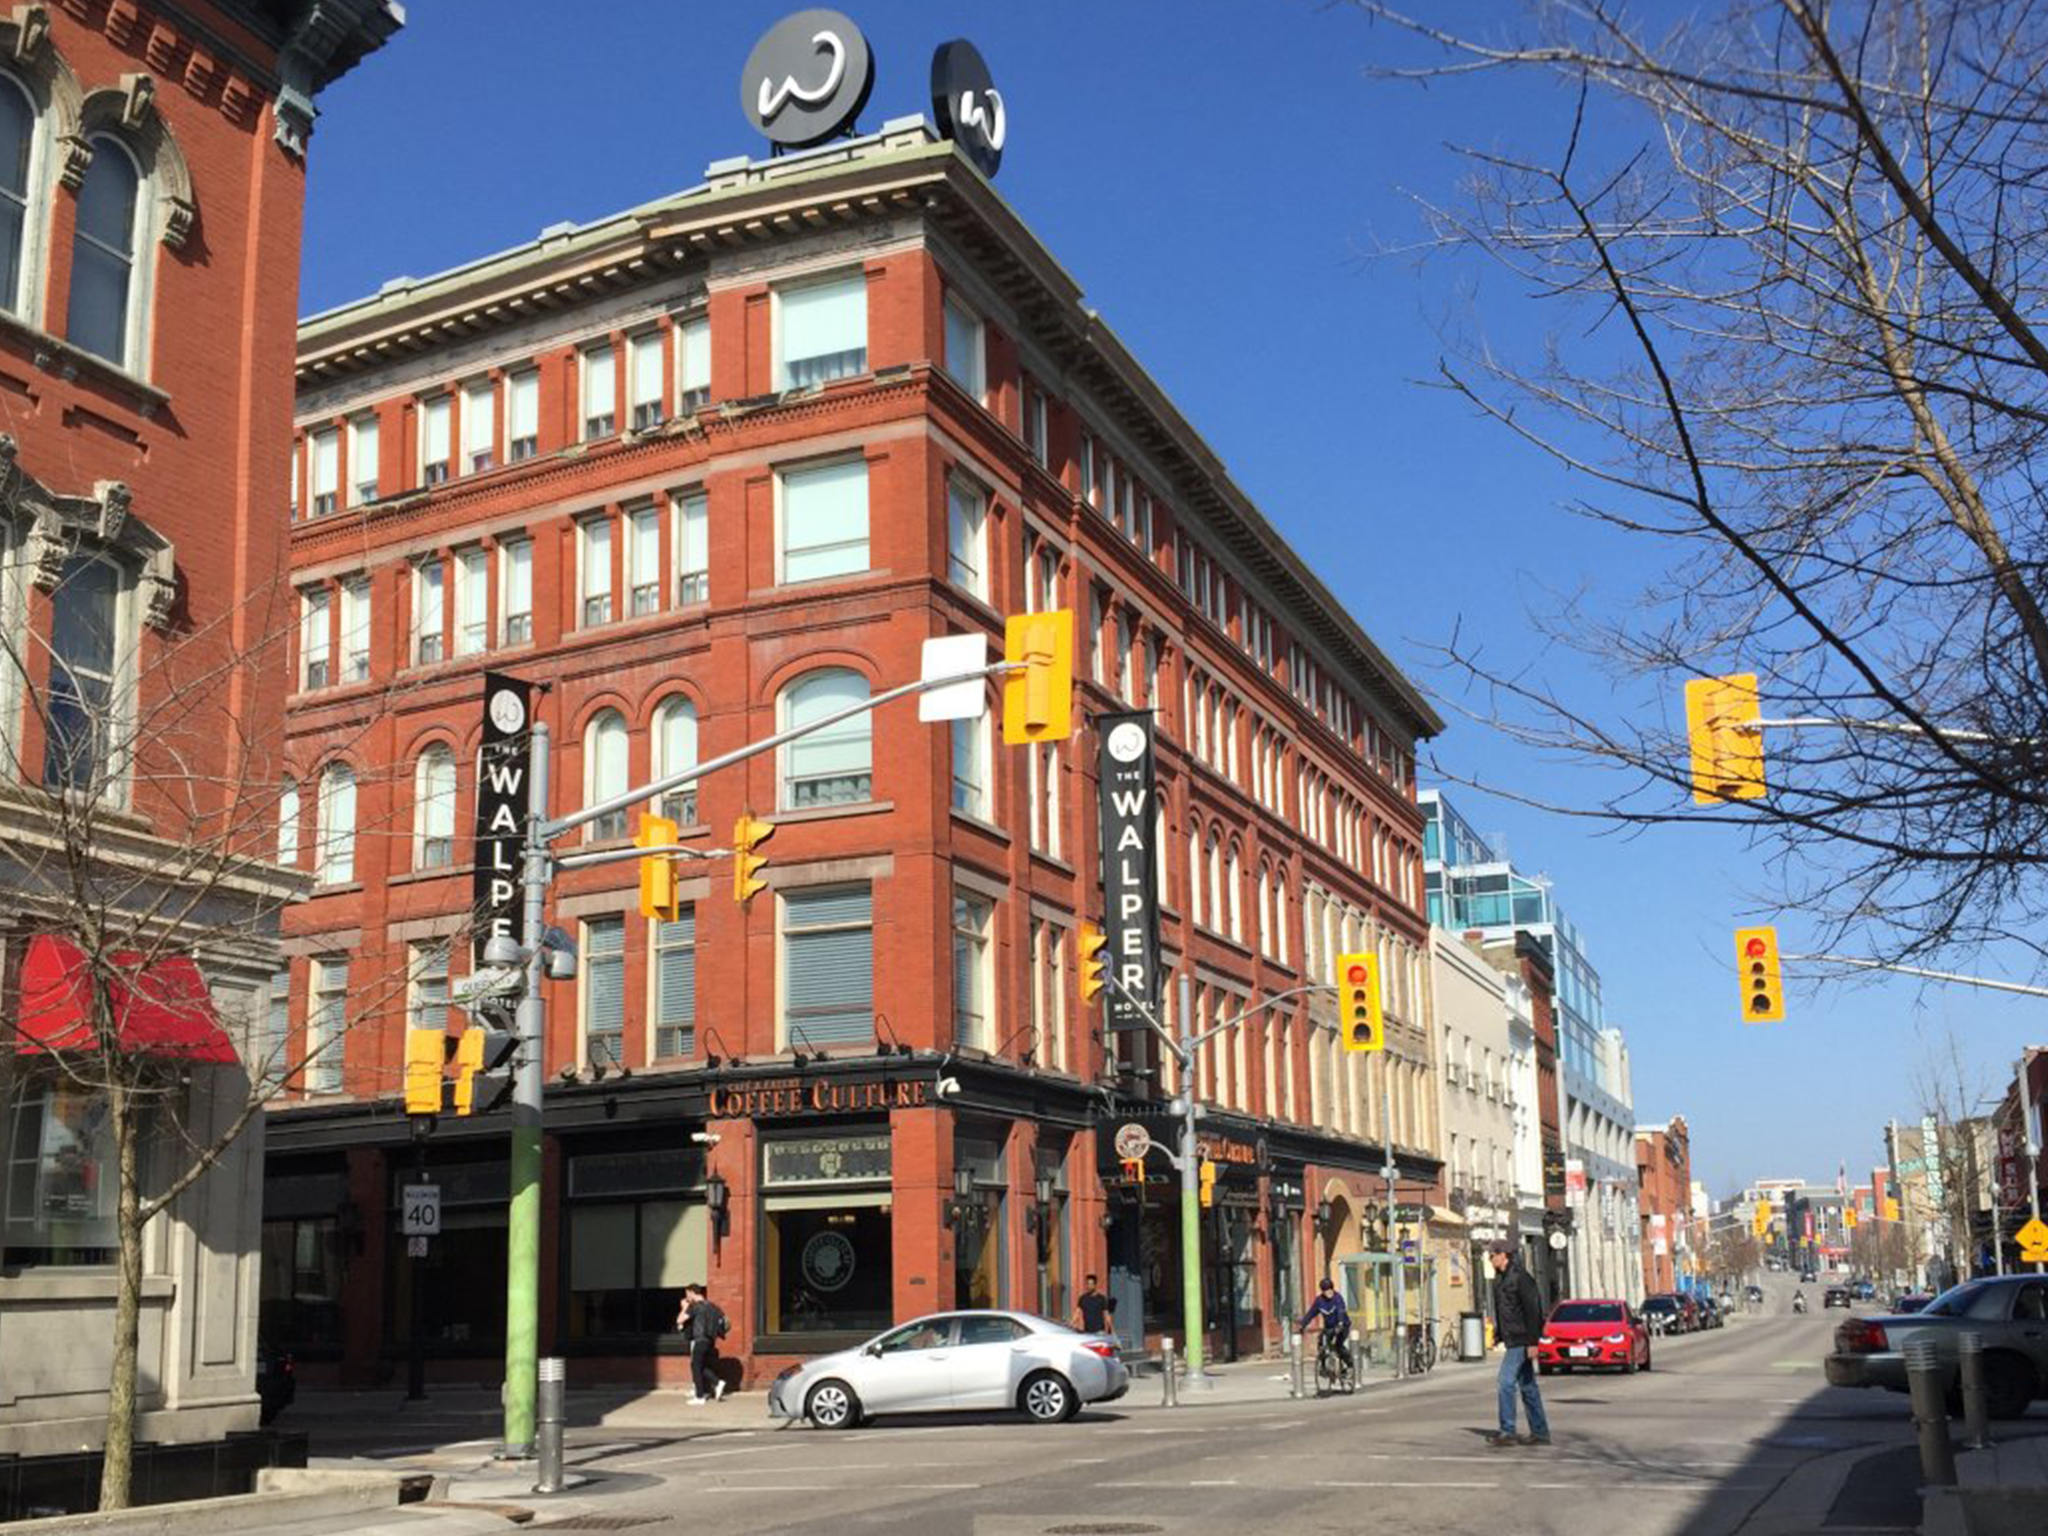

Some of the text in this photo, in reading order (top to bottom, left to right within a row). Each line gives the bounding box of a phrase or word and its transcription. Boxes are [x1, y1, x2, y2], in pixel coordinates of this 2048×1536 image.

[1116, 771, 1141, 781] THE
[489, 764, 523, 937] WALPE
[1112, 789, 1147, 991] WALPER
[709, 1079, 926, 1117] COFFEE CULTURE
[407, 1204, 436, 1226] 40
